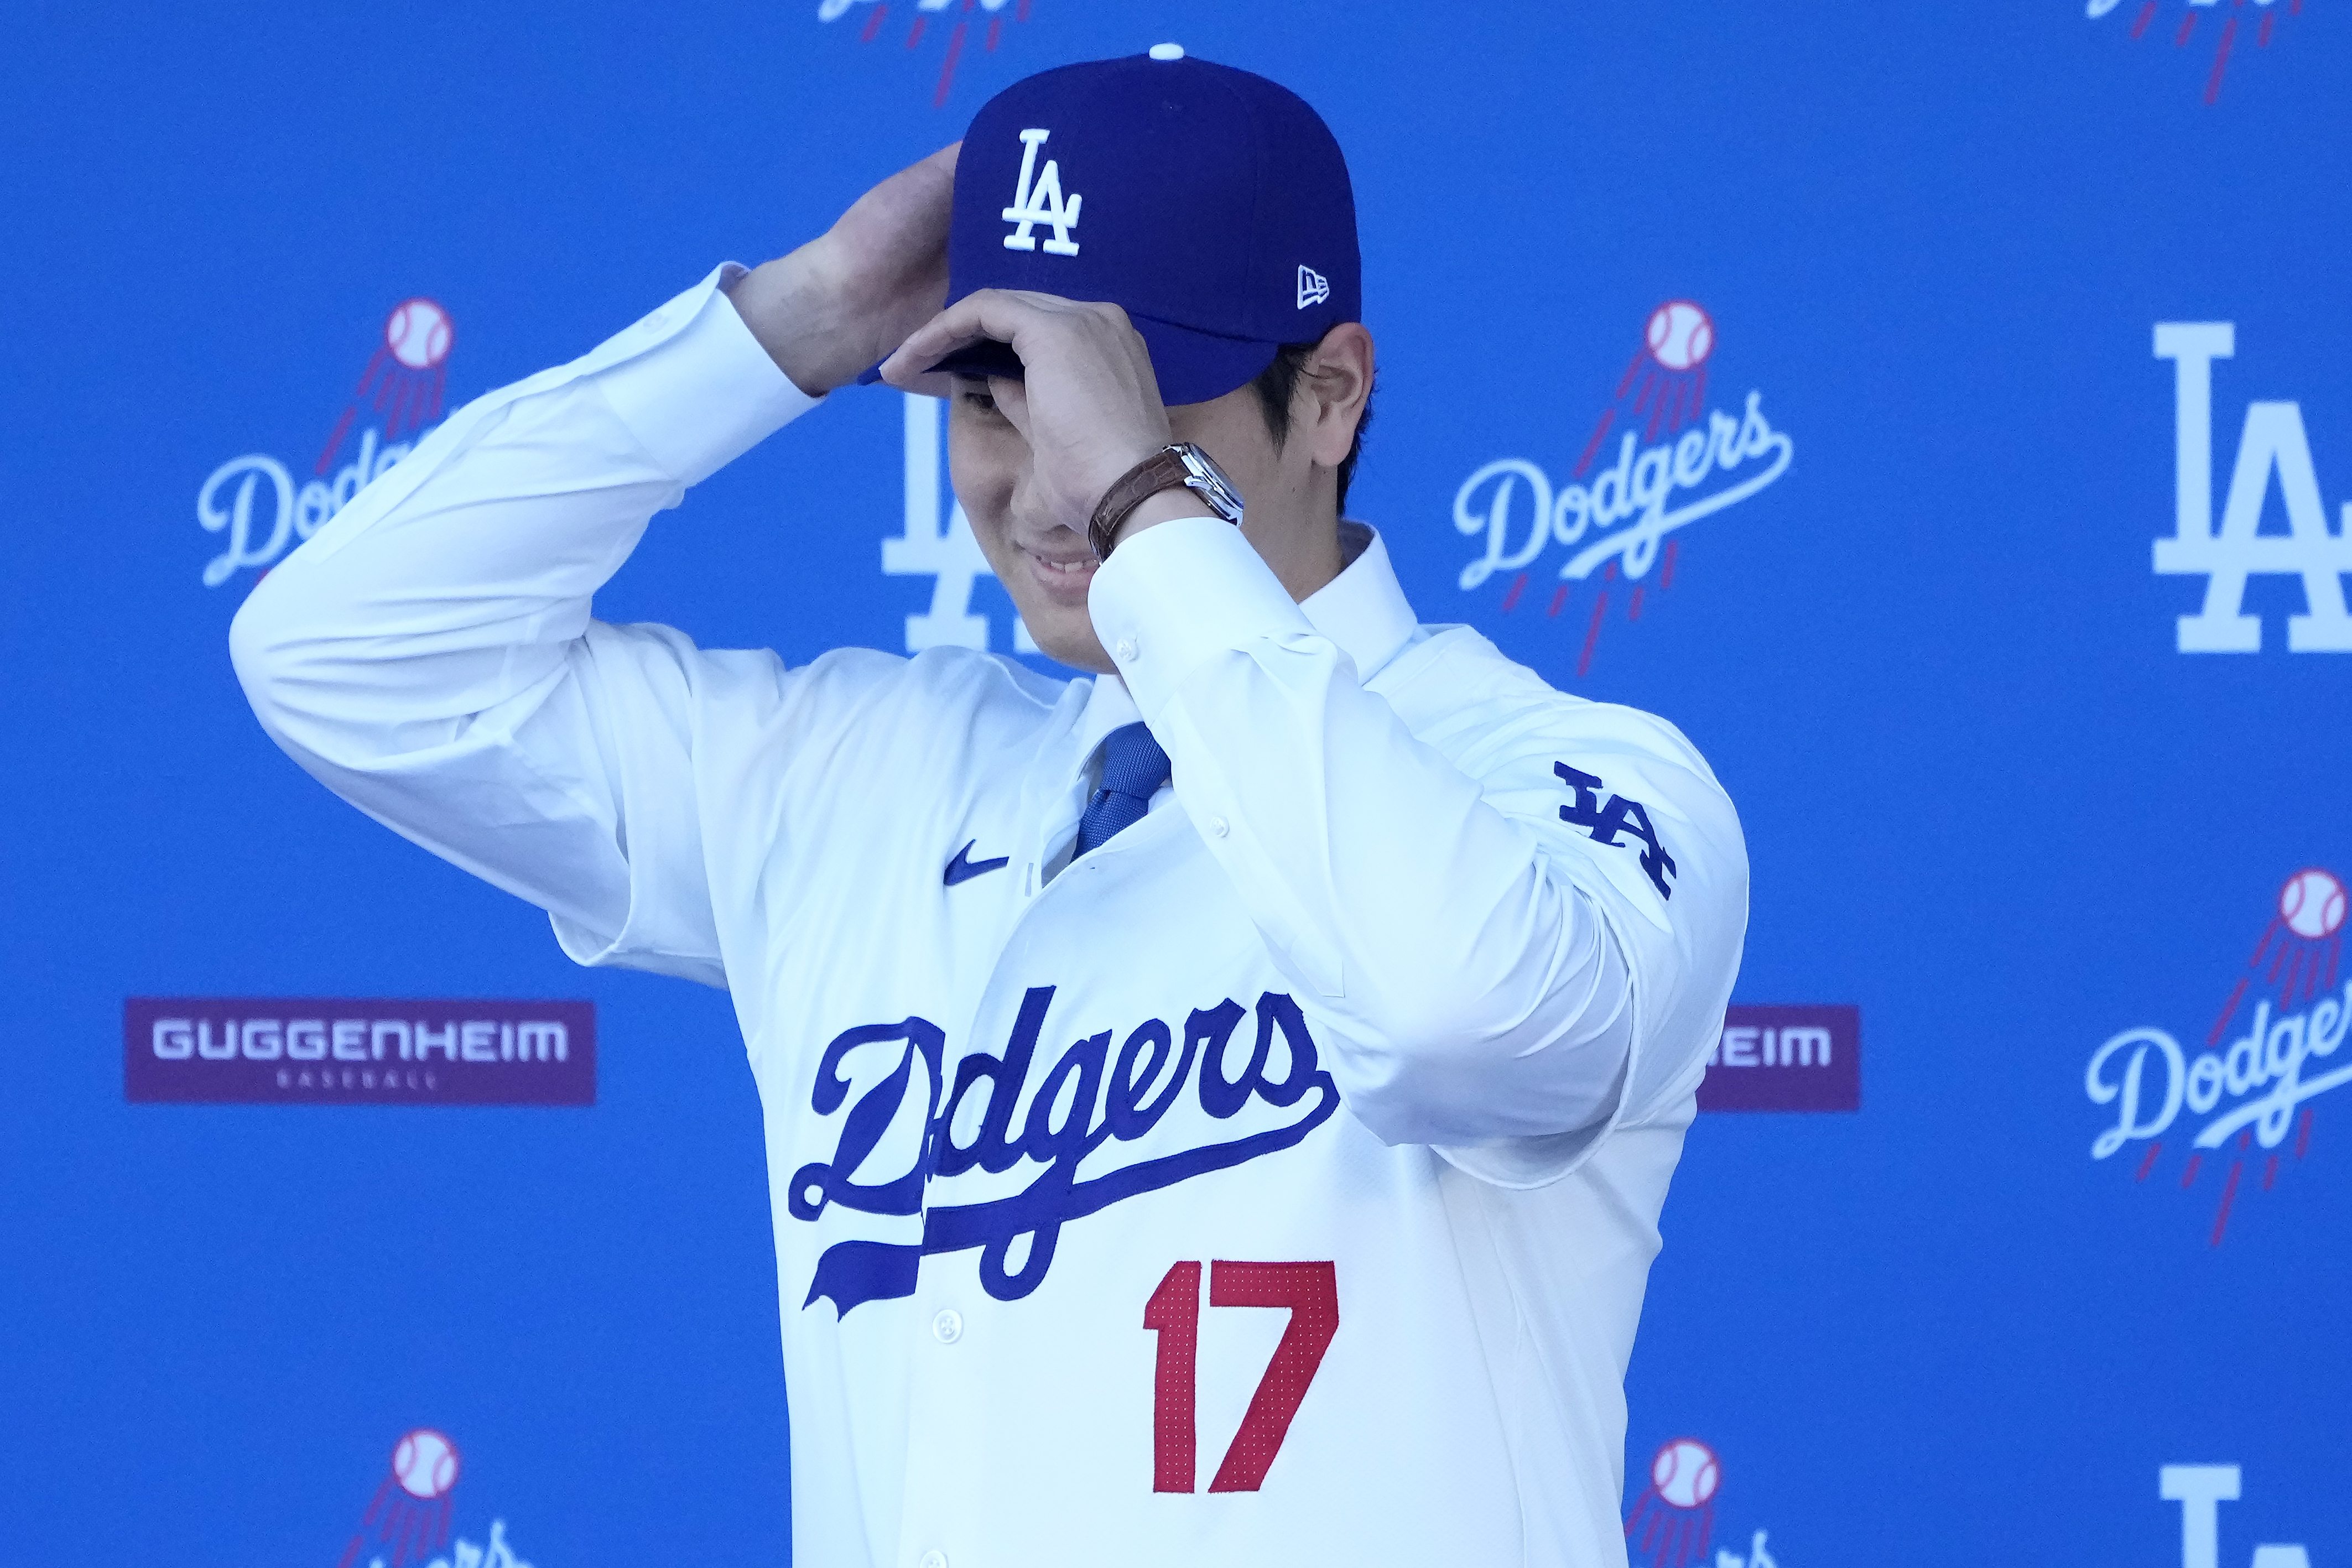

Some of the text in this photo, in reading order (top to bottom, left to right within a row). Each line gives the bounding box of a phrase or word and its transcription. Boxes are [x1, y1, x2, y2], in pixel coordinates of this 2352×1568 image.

[1002, 128, 1083, 257] LA
[1451, 390, 1794, 591] Dodgers
[2151, 321, 2352, 655] LA
[1554, 760, 1677, 901] LA
[152, 1018, 569, 1062] GUGGENHEIM
[2083, 978, 2352, 1160] Dodge
[788, 984, 1341, 1324] Ddgers
[1143, 1259, 1339, 1494] 17
